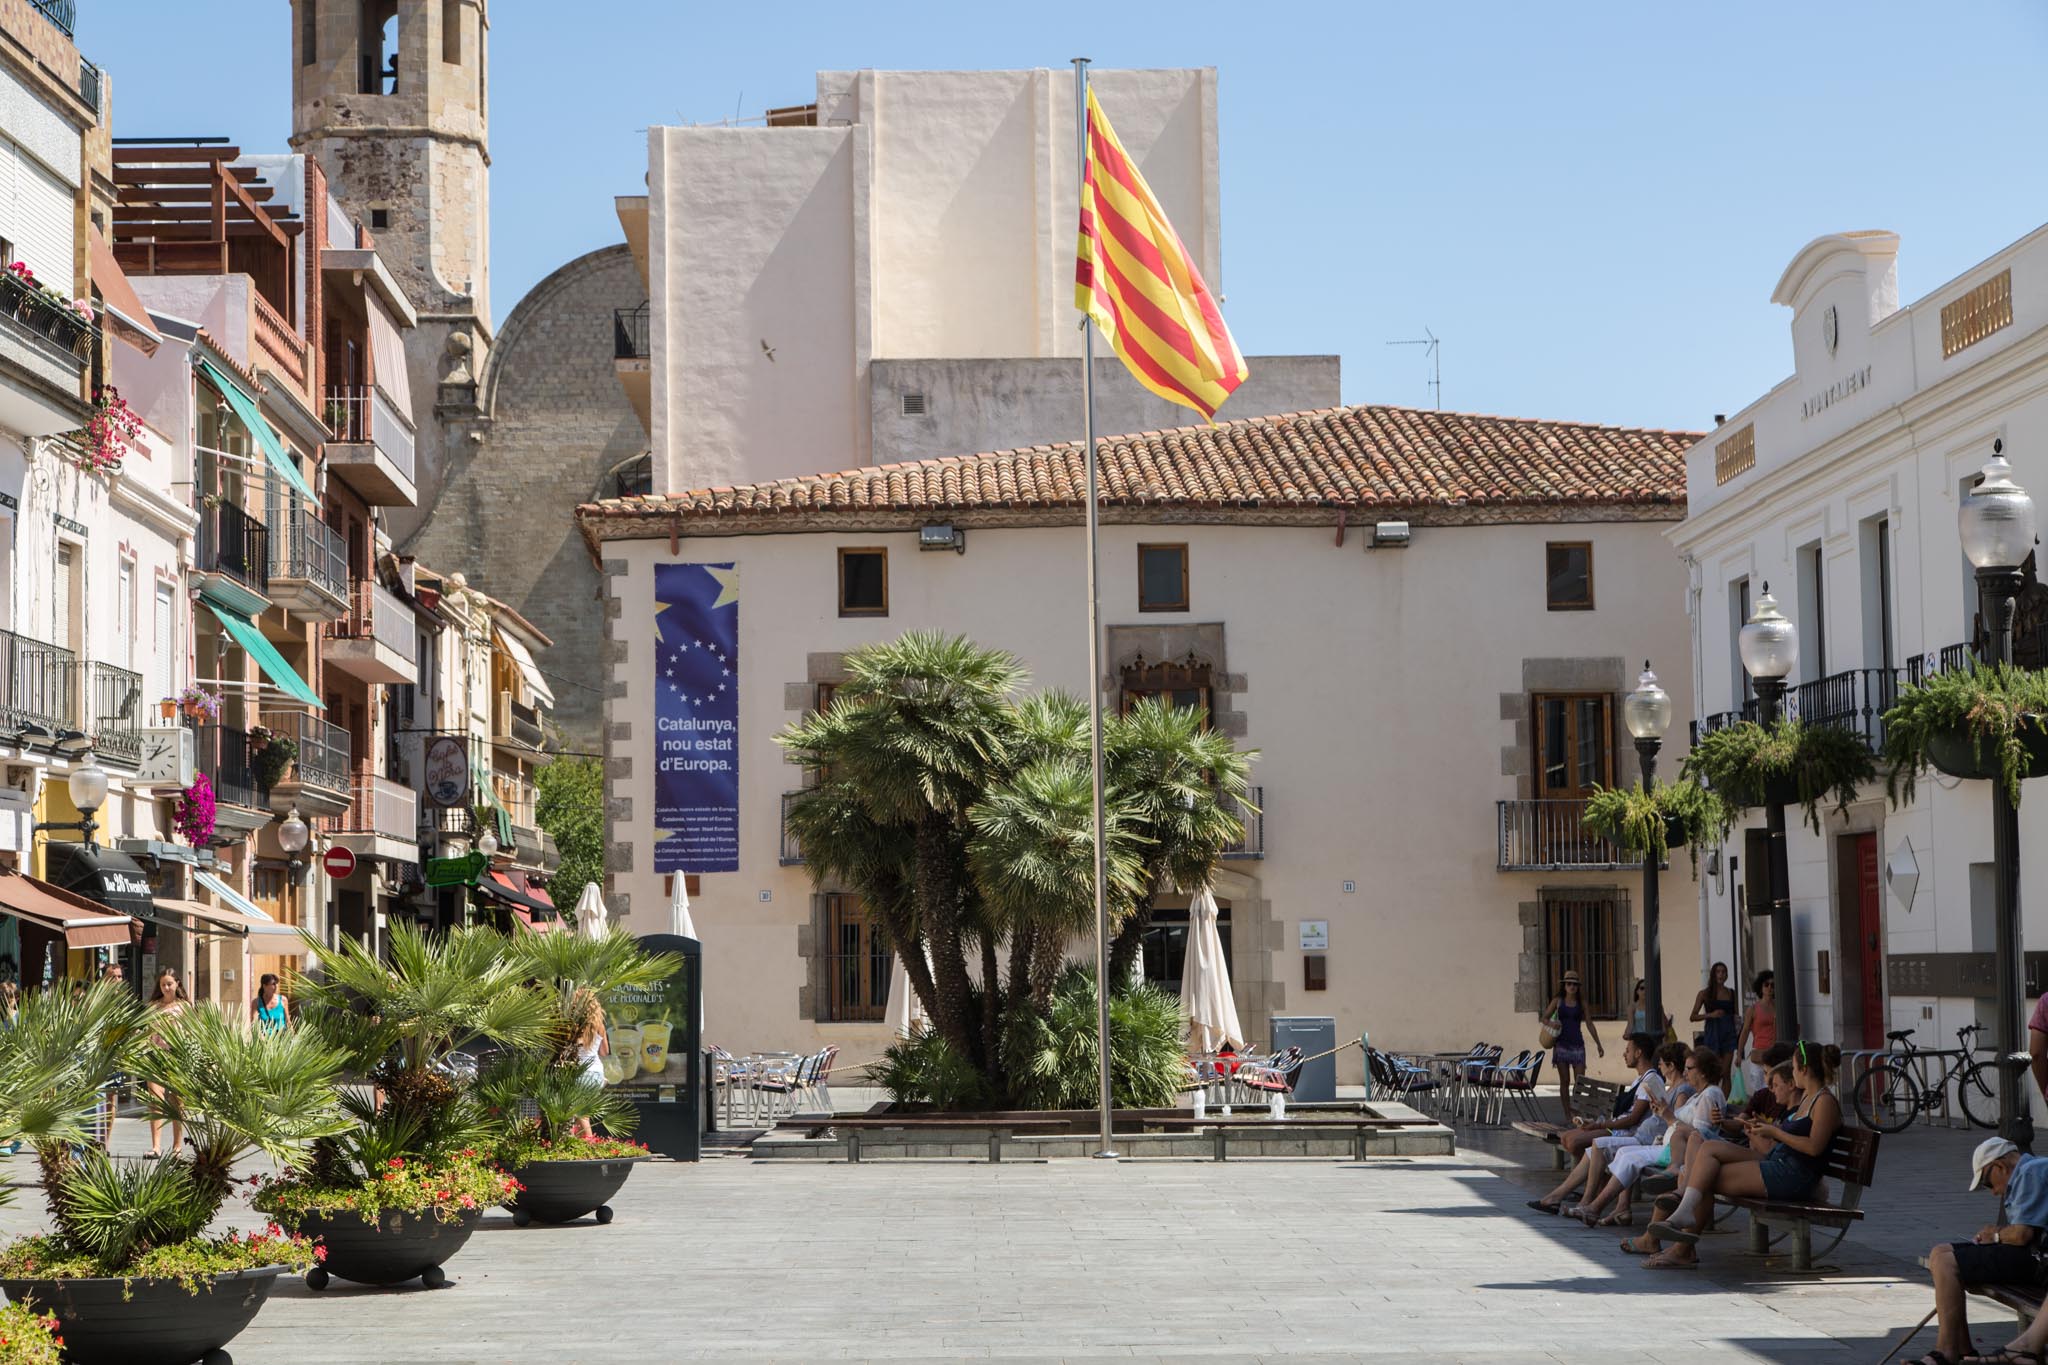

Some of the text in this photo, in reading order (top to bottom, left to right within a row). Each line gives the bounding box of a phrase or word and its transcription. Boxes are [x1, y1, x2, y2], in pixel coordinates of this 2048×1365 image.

[658, 716, 736, 734] Catalunya,
[663, 737, 732, 751] nou estat
[104, 877, 115, 892] Bar
[113, 873, 126, 893] 26
